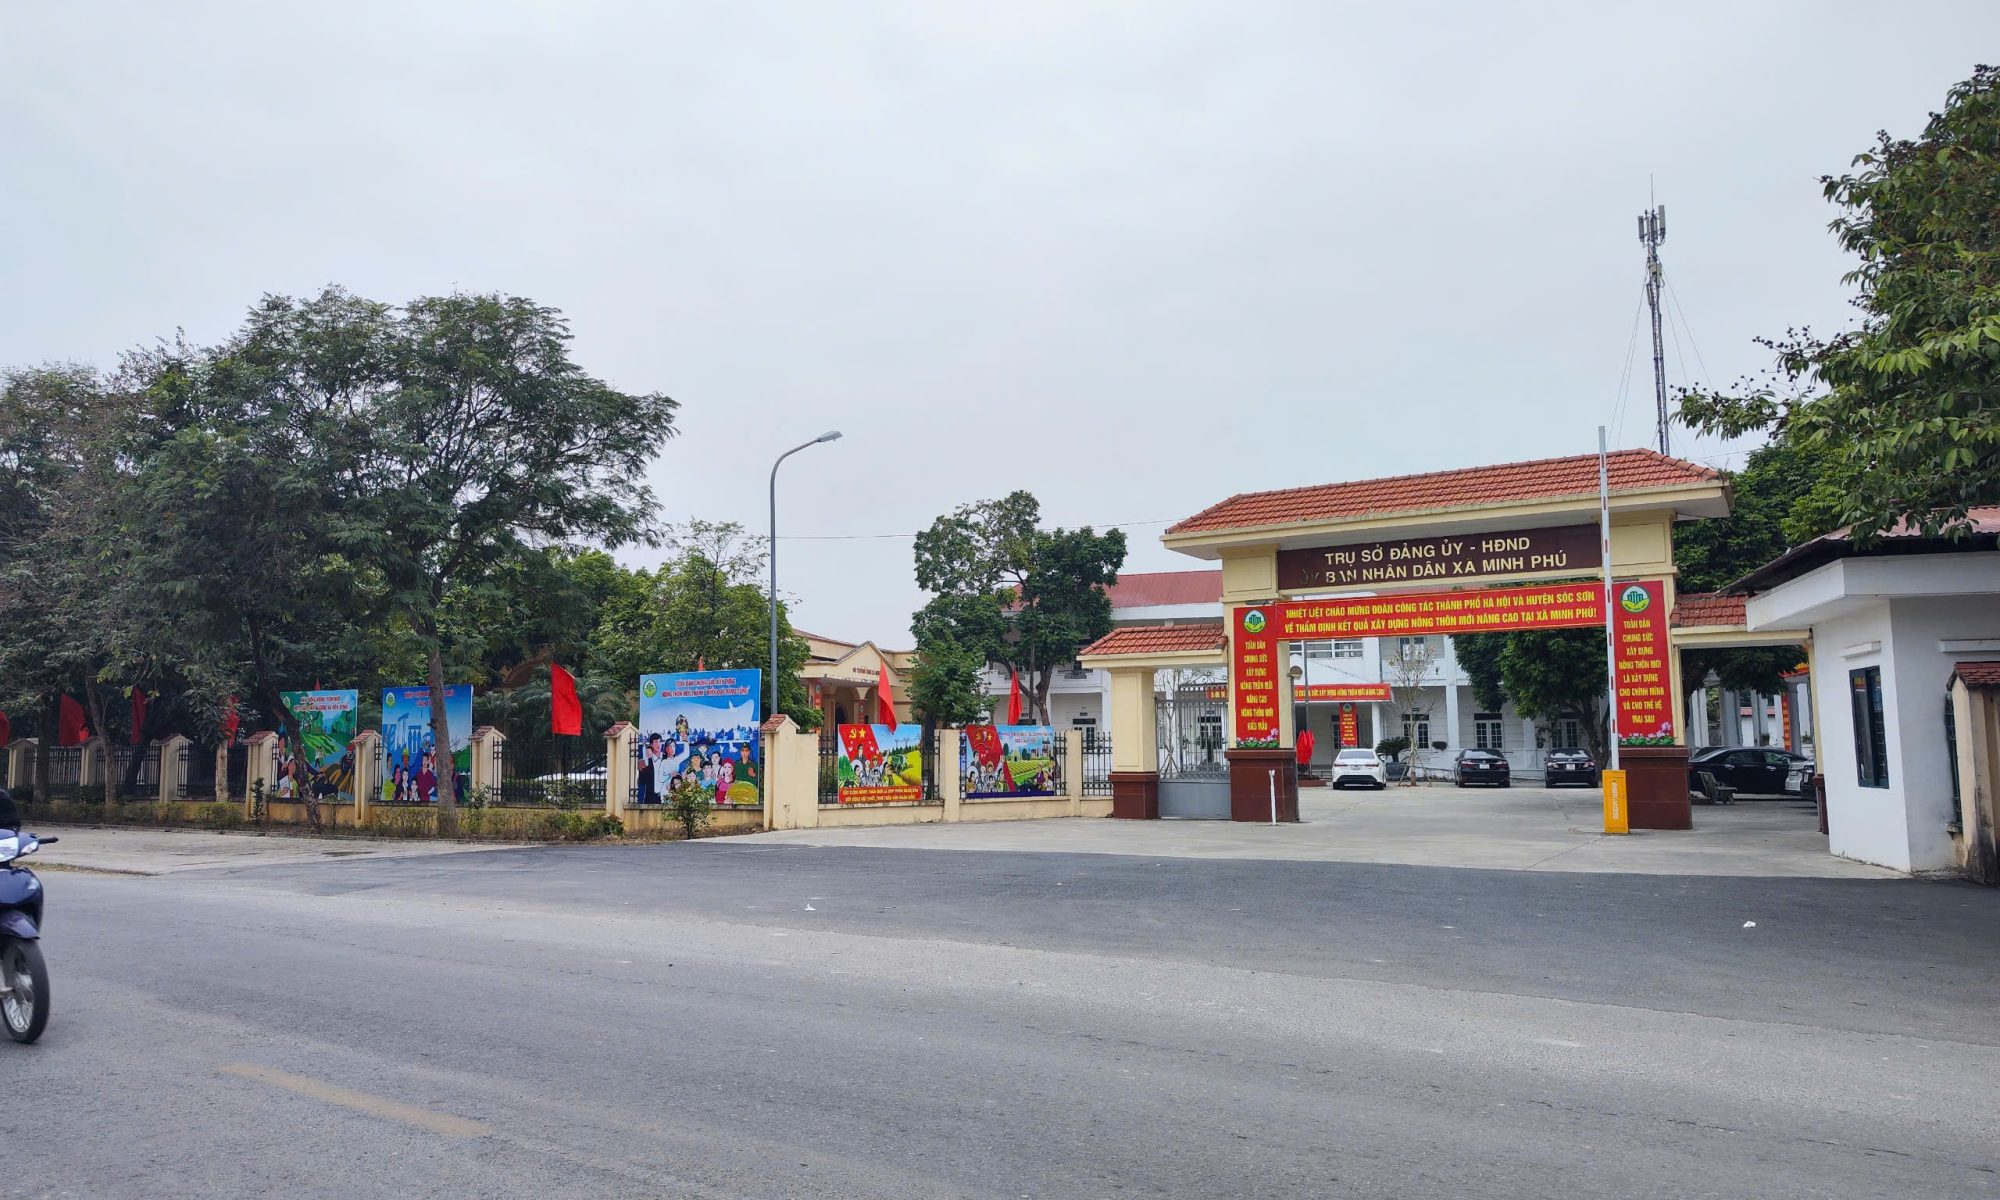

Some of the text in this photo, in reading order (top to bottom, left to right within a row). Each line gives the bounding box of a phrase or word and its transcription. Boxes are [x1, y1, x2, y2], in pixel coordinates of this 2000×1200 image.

[1325, 551, 1356, 567] TRỤ
[1361, 544, 1383, 562] SỞ
[1390, 543, 1435, 560] ĐẢNG
[1441, 539, 1463, 556] ỦY
[1482, 537, 1530, 553] HĐND
[1362, 564, 1407, 581] NHÂN
[1413, 561, 1446, 577] DÂN
[1482, 556, 1524, 573] MINH
[1530, 550, 1567, 568] PHÚ
[1309, 606, 1323, 619] LIỆT
[1326, 605, 1345, 617] CHÀO
[1347, 604, 1370, 616] MỪNG
[1372, 603, 1393, 614] ĐOÀN
[1395, 601, 1417, 613] CÔNG
[1419, 600, 1434, 611] TÁC
[1436, 599, 1462, 611] THÀNH
[1464, 595, 1481, 609] PHỐ
[1496, 595, 1511, 609] NỘI
[1513, 594, 1524, 606] VÀ
[1526, 592, 1555, 607] HUYỆN
[1557, 591, 1574, 604] SÓC
[1576, 591, 1595, 602] SƠN
[1285, 606, 1597, 634] VỀ THẨM ĐỊNH KẾT QUẢ XÂY DỰNG NÔNG THÔN MỚI NÂNG CAO TẠI XÃ MINH PHÚ!
[1622, 632, 1654, 643] CHUNG SỨC
[1626, 646, 1637, 656] XÂY
[1631, 673, 1642, 683] XÂY
[1643, 673, 1658, 684] DỰNG
[1619, 687, 1630, 697] CHO
[1631, 701, 1643, 710] CHO
[1644, 714, 1655, 723] SAU
